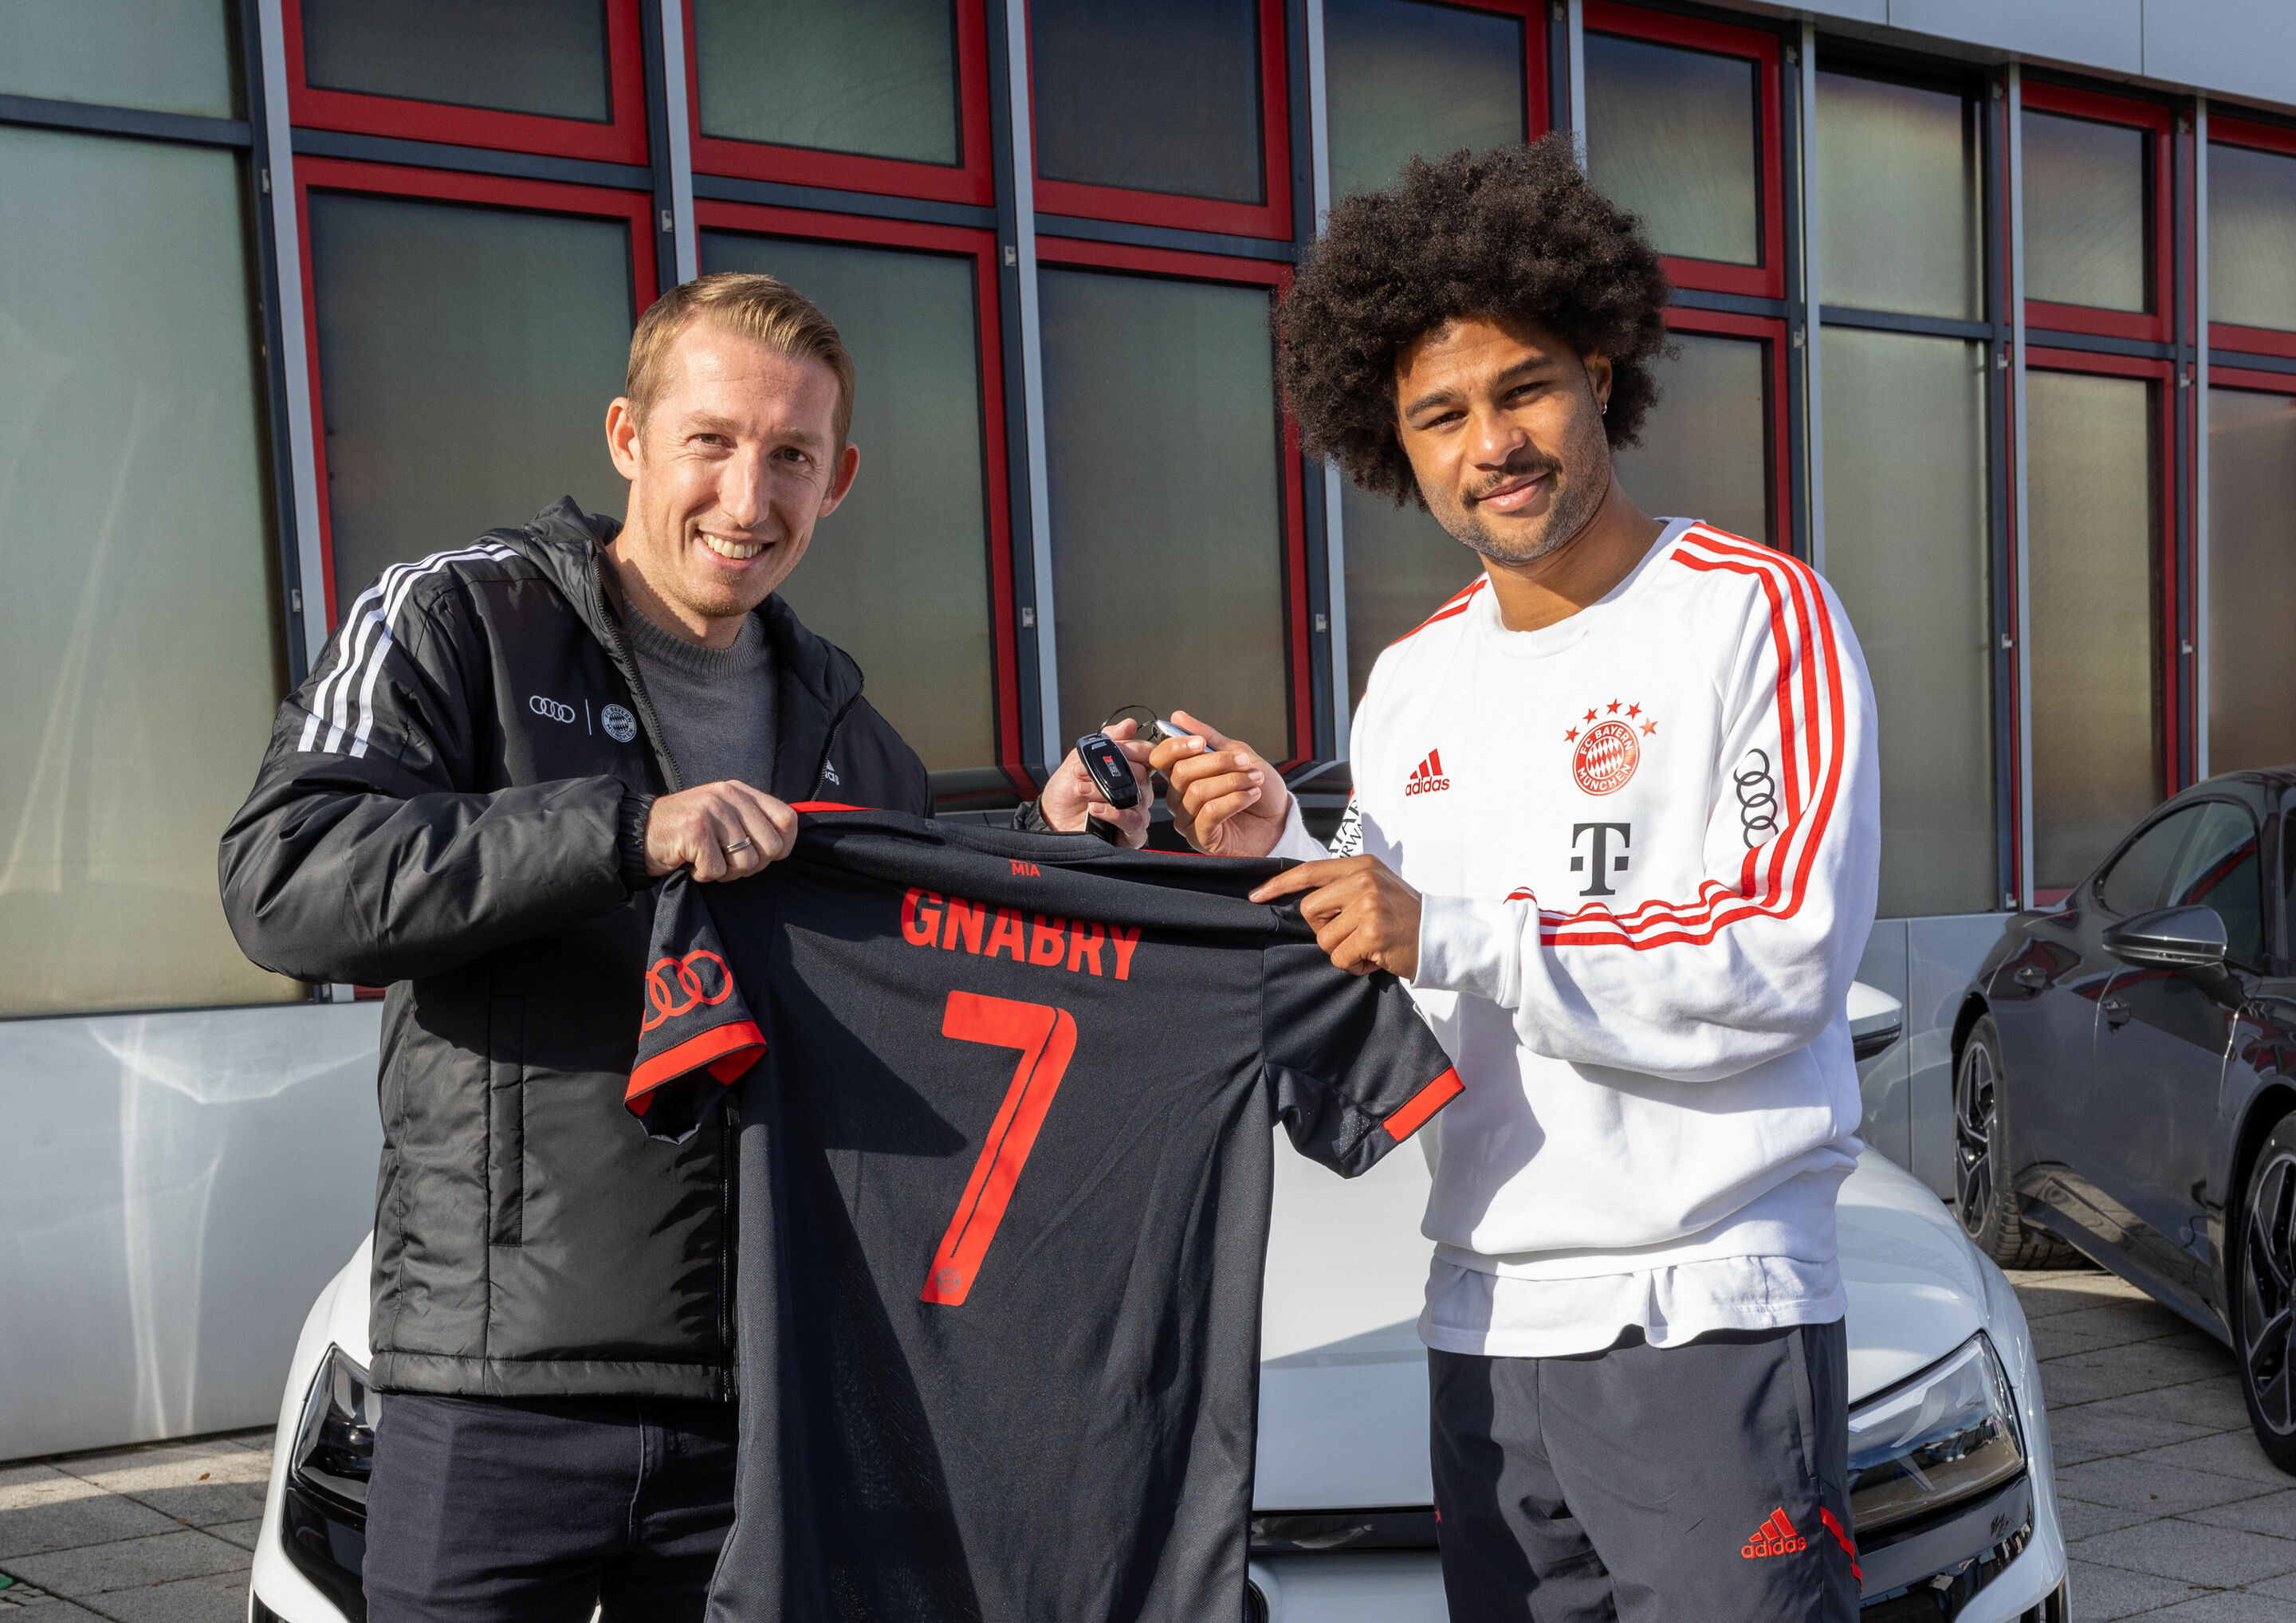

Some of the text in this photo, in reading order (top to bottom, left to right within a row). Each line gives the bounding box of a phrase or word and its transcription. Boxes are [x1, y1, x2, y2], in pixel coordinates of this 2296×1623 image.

[610, 706, 633, 723] BAYERN
[1580, 725, 1634, 756] FC BAYERN
[1406, 776, 1450, 796] adidas
[1012, 863, 1041, 877] MIA
[1571, 823, 1630, 896] T
[901, 886, 1142, 980] GNABRY
[920, 990, 1077, 1307] 7
[1740, 1537, 1808, 1559] adidas
